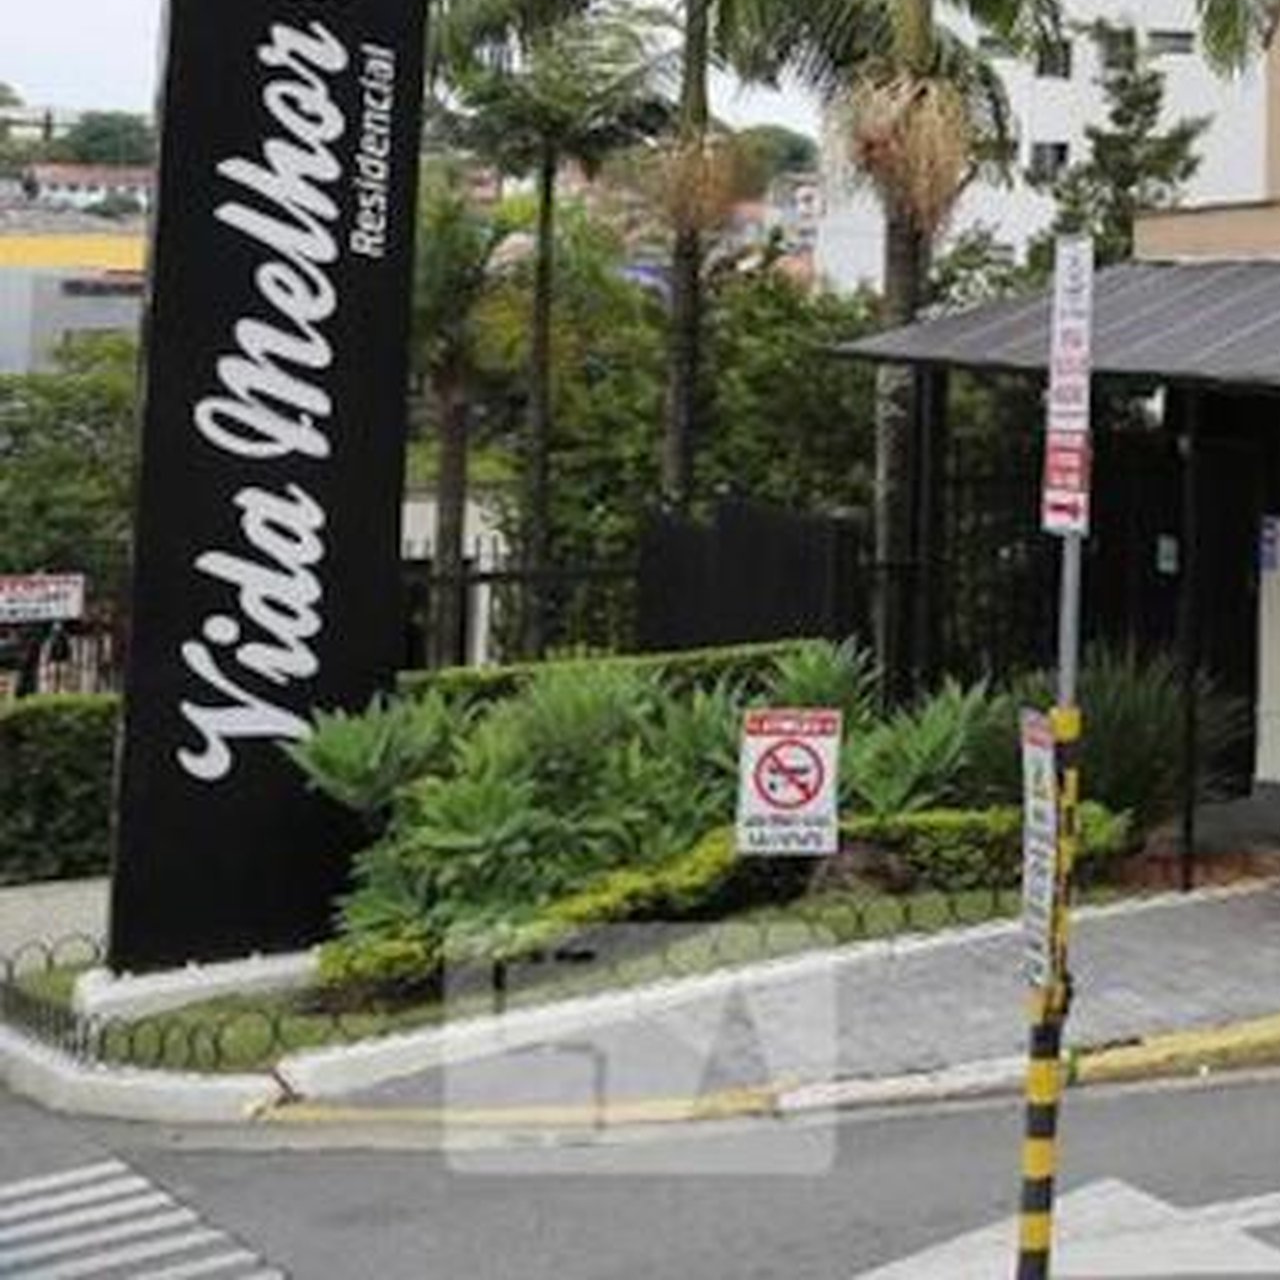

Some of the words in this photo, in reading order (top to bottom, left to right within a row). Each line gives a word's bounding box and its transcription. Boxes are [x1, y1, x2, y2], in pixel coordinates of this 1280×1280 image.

[194, 21, 350, 459] Melhor
[349, 43, 396, 258] Residencial
[176, 483, 327, 781] Vida
